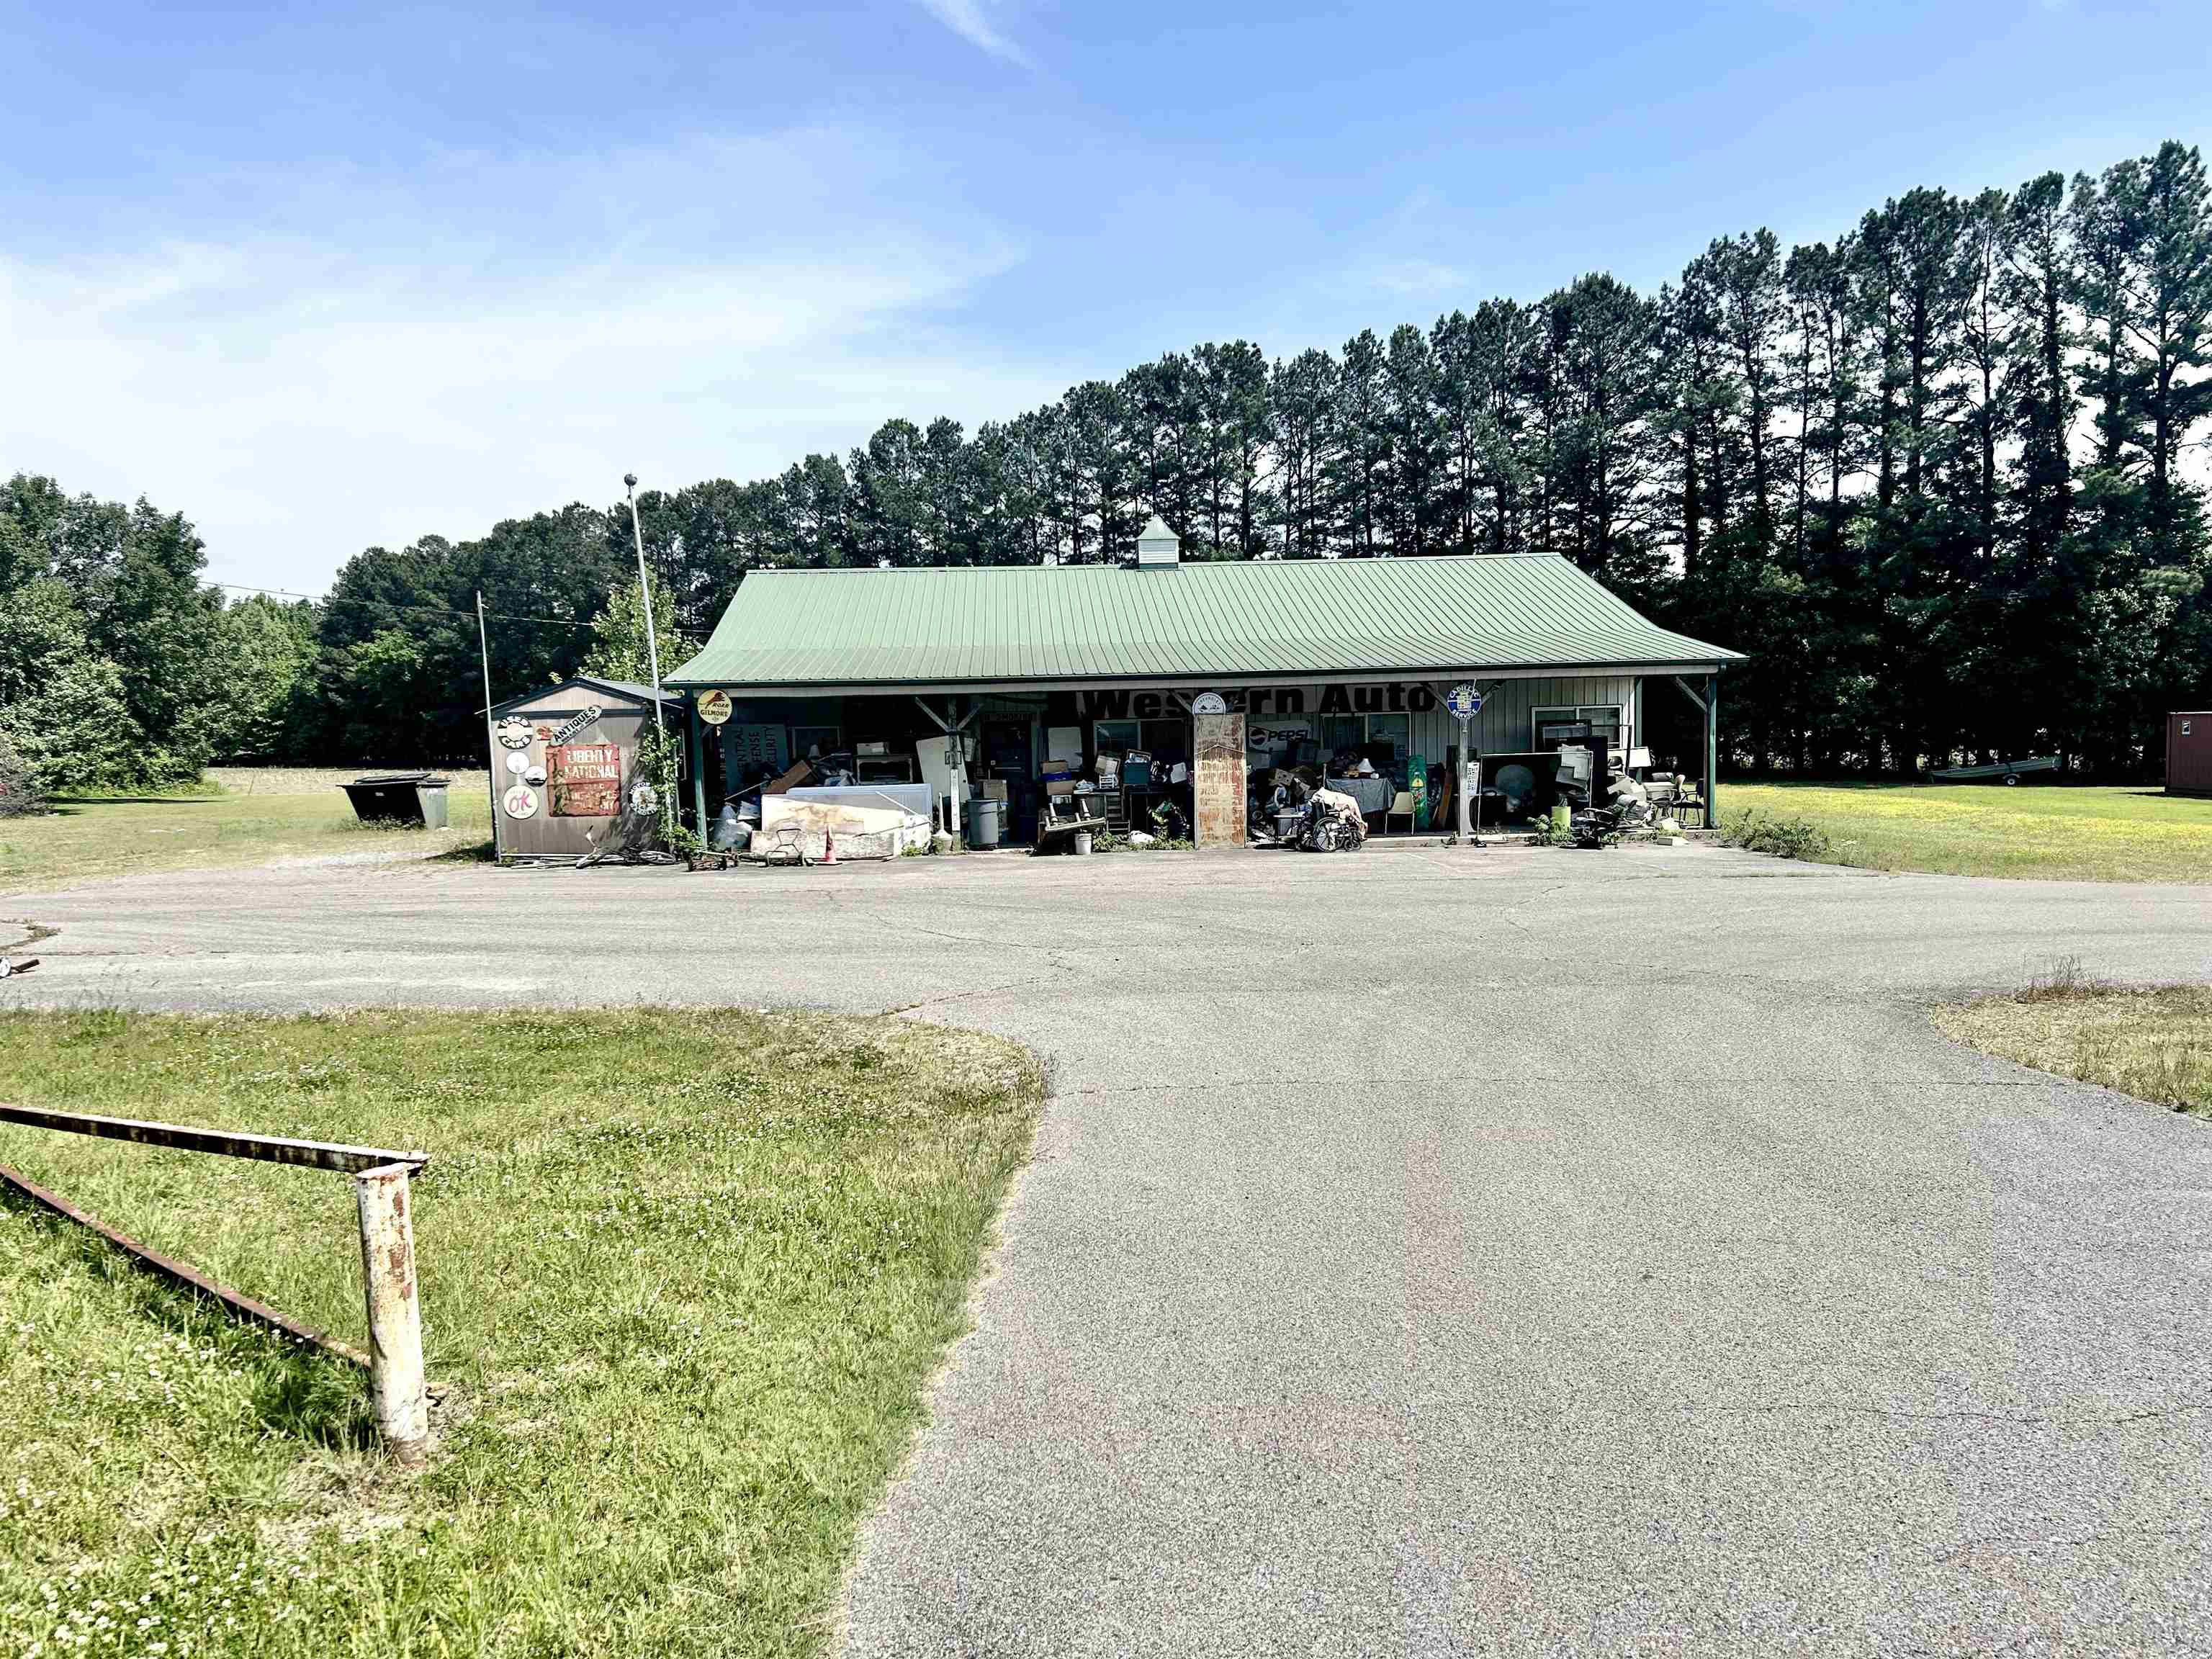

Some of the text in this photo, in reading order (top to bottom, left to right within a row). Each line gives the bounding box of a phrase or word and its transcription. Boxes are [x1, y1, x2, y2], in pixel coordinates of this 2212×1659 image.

[1085, 683, 1436, 719] Wesern Auto
[1452, 709, 1478, 719] SERVICE
[500, 716, 529, 727] USED
[553, 706, 596, 742] ANTIQUES
[502, 736, 531, 748] CARS
[565, 765, 619, 778] NATIONAL
[508, 790, 533, 813] OK
